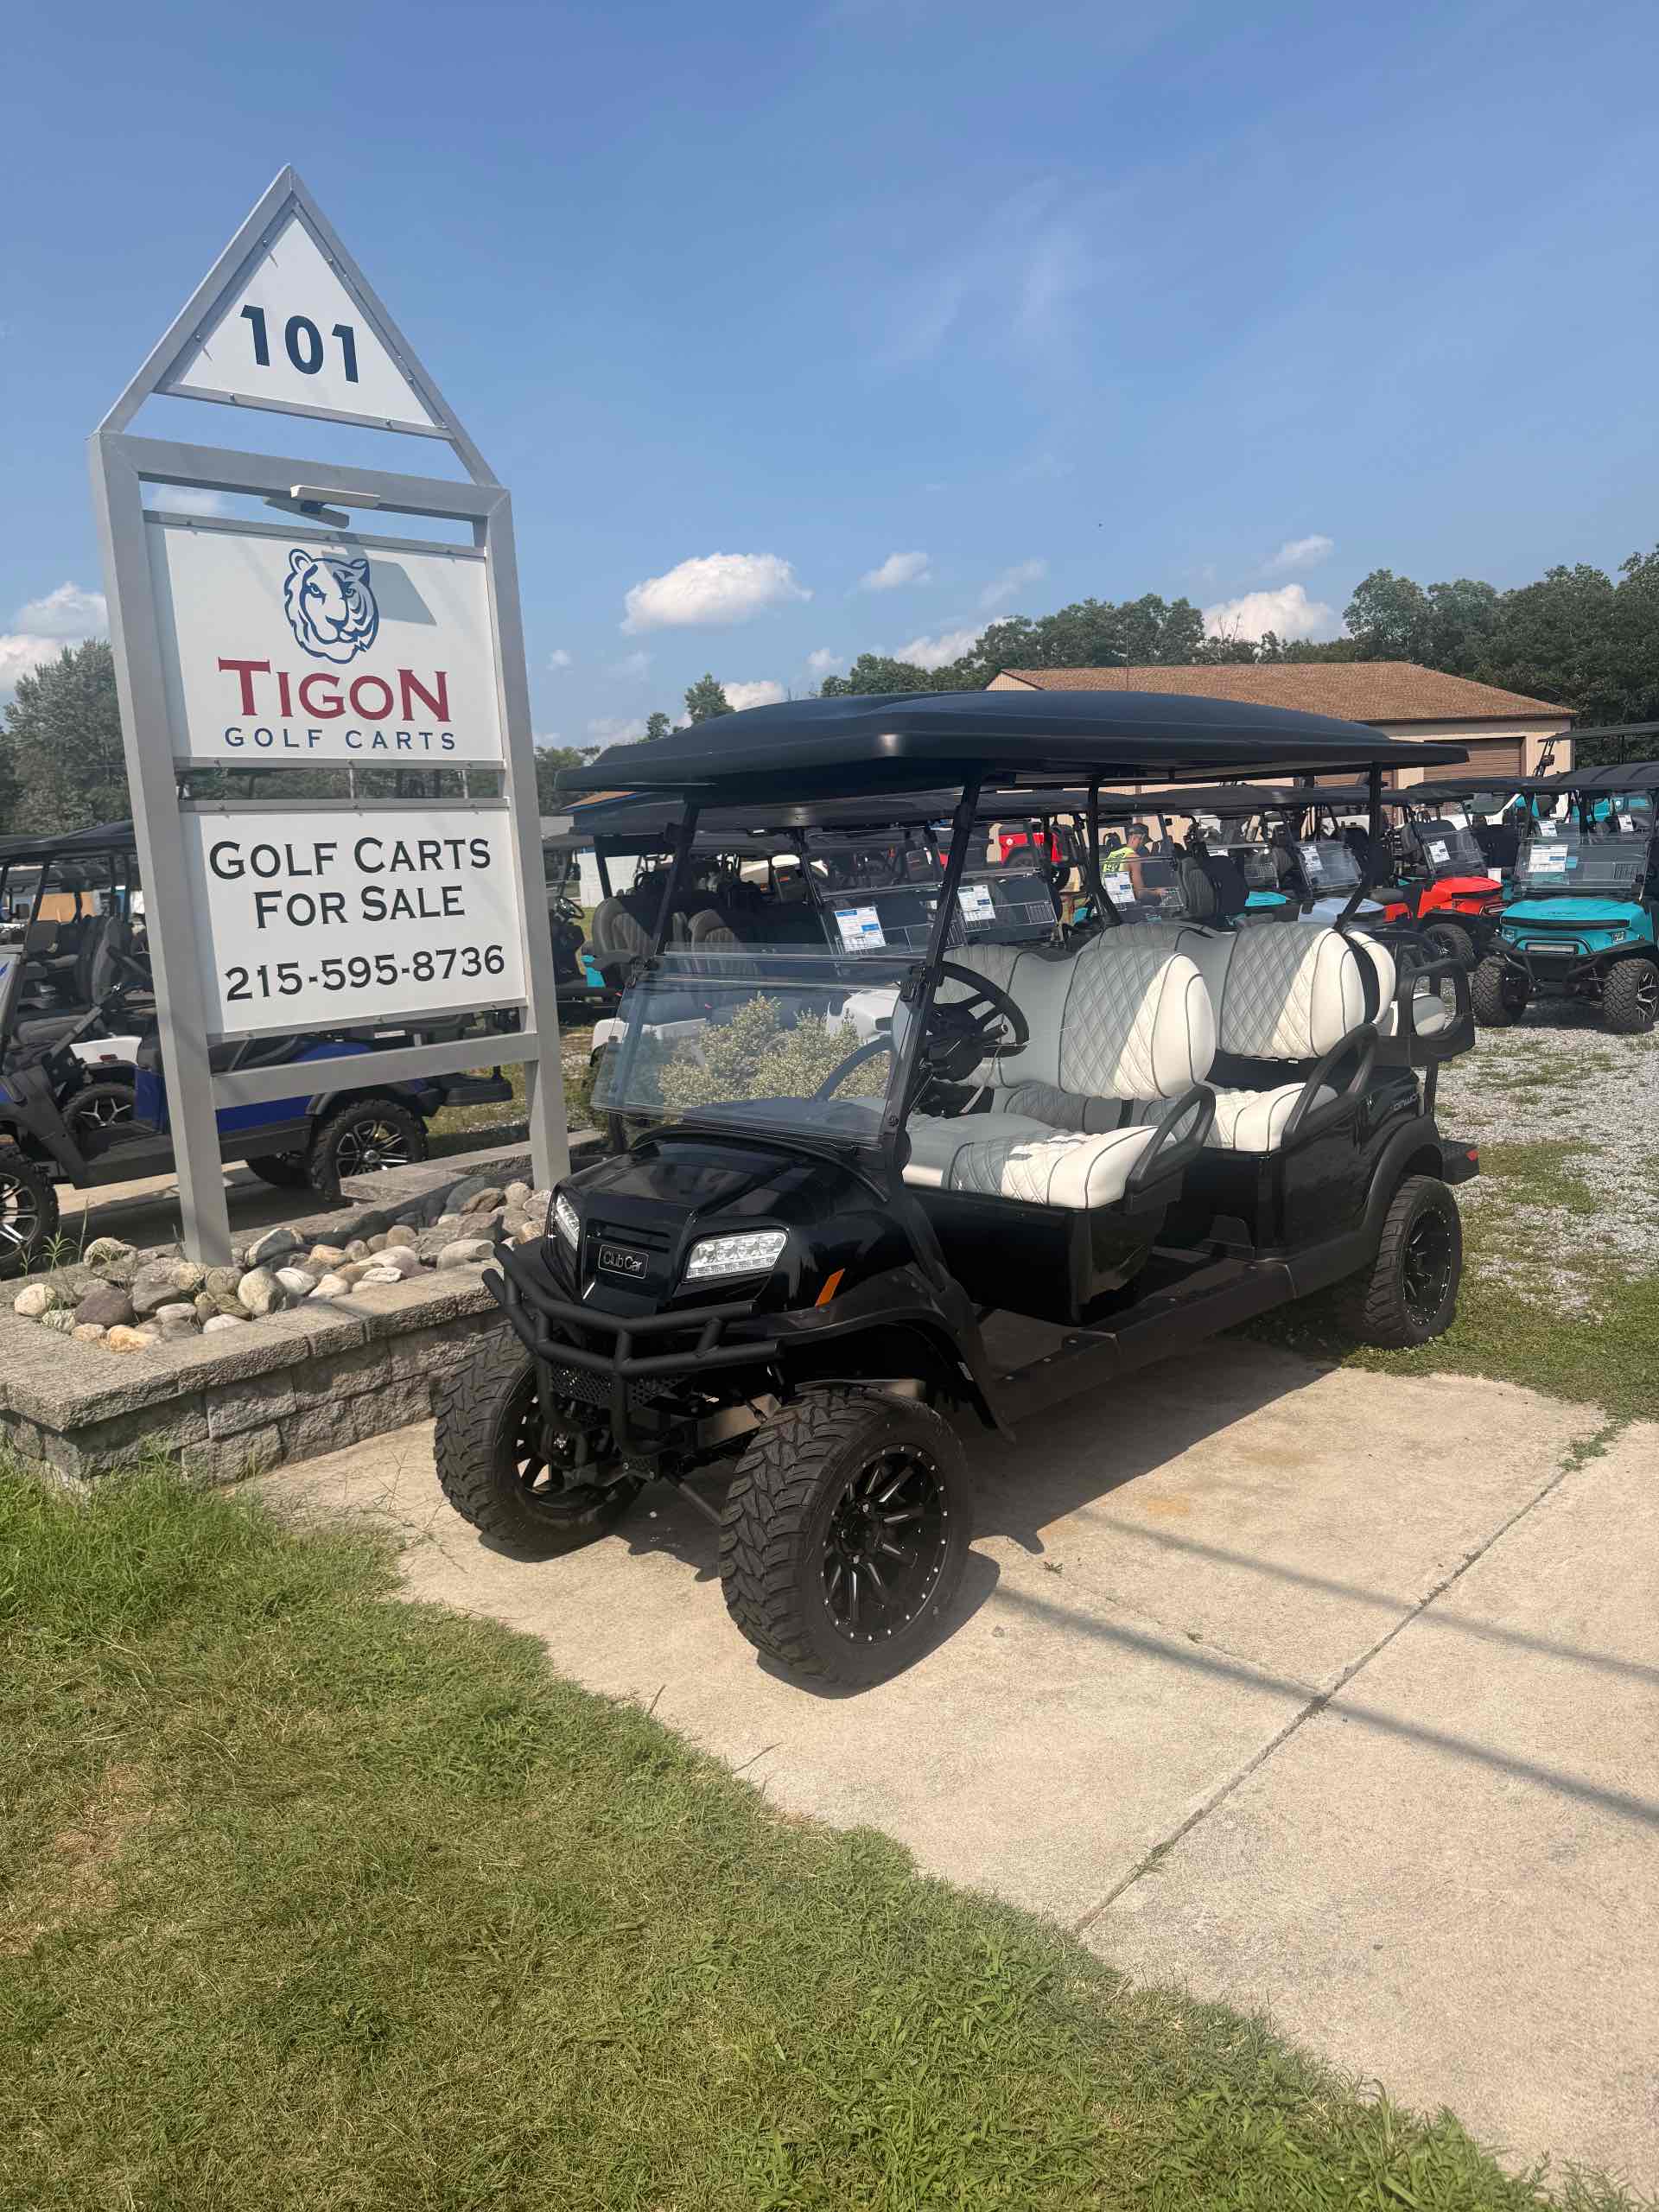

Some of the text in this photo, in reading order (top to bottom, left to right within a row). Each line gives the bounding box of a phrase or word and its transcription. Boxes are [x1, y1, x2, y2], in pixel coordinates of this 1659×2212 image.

[239, 304, 359, 384] 101
[218, 657, 452, 722] TIGON
[225, 727, 456, 751] GOLF CARTS
[209, 837, 492, 880] GOLF CARTS
[253, 885, 466, 929] FOR SALE
[224, 944, 505, 1002] 215-595-8736
[603, 1250, 643, 1272] Club Car
